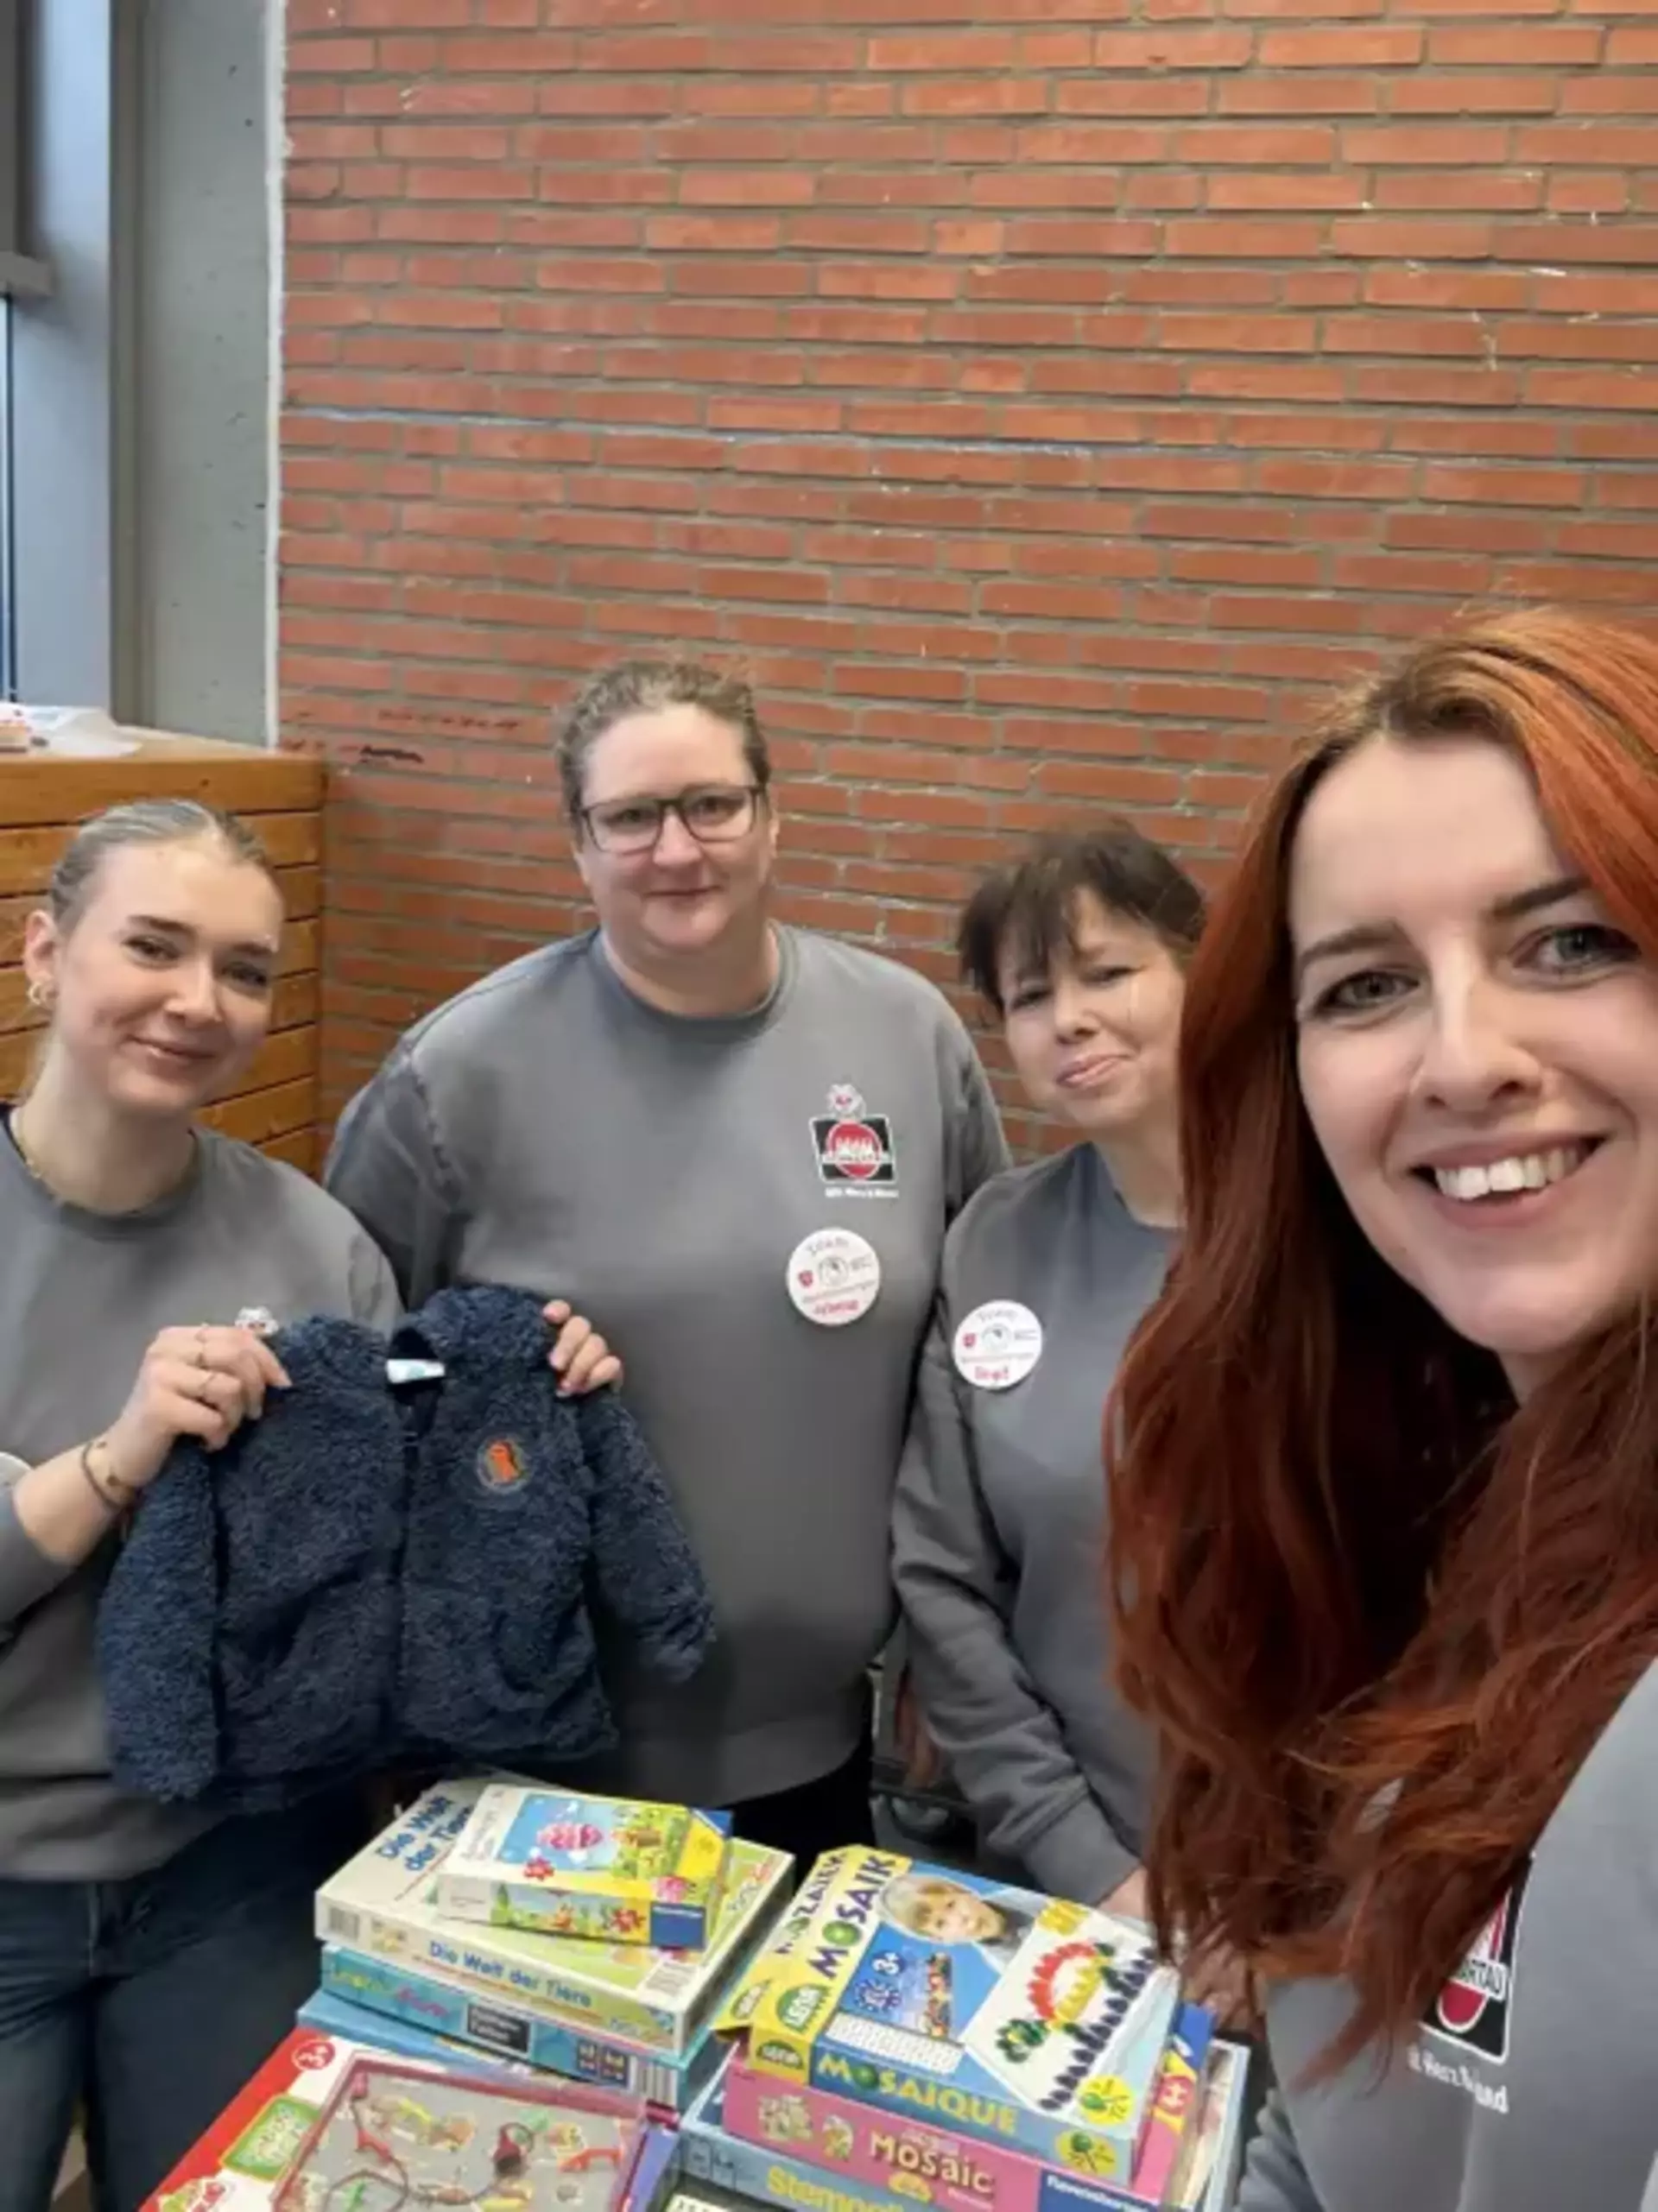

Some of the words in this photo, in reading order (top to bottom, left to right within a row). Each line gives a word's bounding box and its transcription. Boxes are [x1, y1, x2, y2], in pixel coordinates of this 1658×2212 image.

[807, 1856, 896, 1979] MOSAIK
[429, 1940, 459, 1964] Die
[463, 1950, 504, 1978] Welt
[509, 1968, 539, 1990] der
[547, 1978, 592, 2007] Tiere
[818, 2052, 1017, 2137] MOSAIQUE
[869, 2129, 994, 2195] Mosaic
